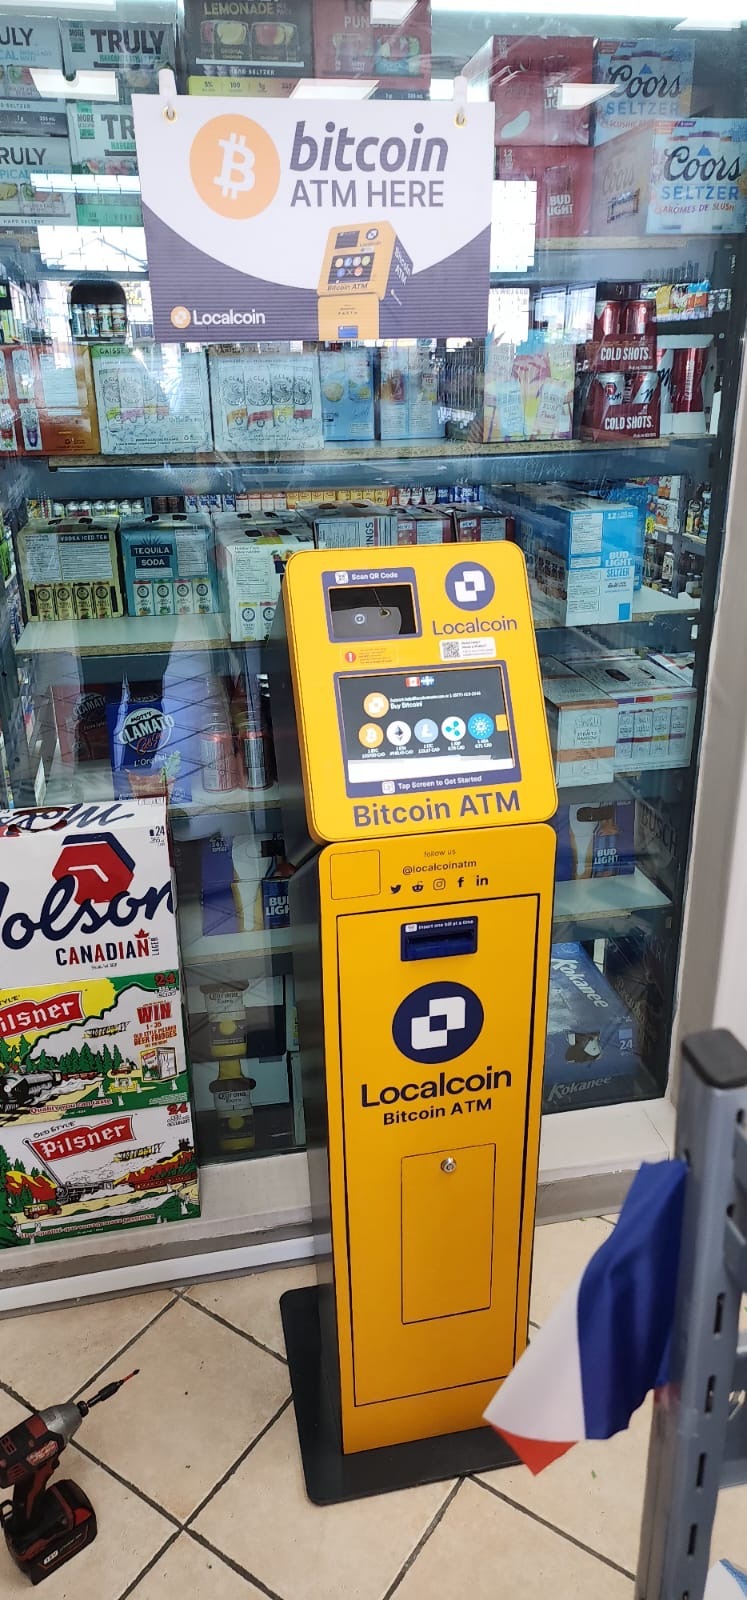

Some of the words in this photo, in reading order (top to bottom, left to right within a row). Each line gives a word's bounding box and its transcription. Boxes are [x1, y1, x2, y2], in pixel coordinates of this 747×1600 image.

[203, 2, 274, 15] LEMONADE
[90, 28, 165, 55] TRULY
[608, 64, 681, 98] Coors
[606, 101, 679, 116] SELTZER
[77, 113, 94, 123] MORE
[289, 120, 449, 173] bitcoin
[663, 145, 741, 182] Coors
[289, 179, 357, 208] ATM
[367, 179, 445, 207] HERE
[550, 194, 571, 205] BUD
[661, 185, 739, 201] SELTZER
[547, 204, 574, 216] LIGHT
[192, 308, 266, 326] Localcoin
[600, 346, 622, 361] COLD
[604, 417, 626, 431] COLD
[134, 547, 170, 555] TEQUILA
[608, 551, 630, 560] BUD
[141, 558, 165, 567] SODA
[605, 559, 633, 567] LIGHT
[380, 572, 398, 580] Code
[606, 568, 630, 578] SELTZER
[432, 615, 518, 636] Localcoin
[120, 714, 175, 745] CLAMATO
[398, 782, 411, 790] Tap
[412, 780, 435, 788] Screen
[457, 775, 482, 783] Started
[352, 797, 451, 827] Bitcoin
[460, 790, 521, 817] ATM
[155, 825, 165, 836] 24
[594, 854, 620, 865] LIGHT
[597, 847, 617, 857] BUD
[402, 860, 477, 875] @localcoinatm
[0, 874, 174, 950] olson
[55, 937, 150, 967] CANADIAN
[154, 971, 176, 987] 24
[551, 958, 609, 1008] Kokanee
[0, 999, 74, 1034] ilsner
[137, 1002, 172, 1024] WIN
[134, 1037, 150, 1046] BEER
[151, 1031, 177, 1042] FRIDGES
[620, 1039, 633, 1050] 24
[361, 1065, 513, 1108] Localcoin
[548, 1077, 612, 1101] Kokanee
[30, 1105, 59, 1115] Quality
[61, 1102, 75, 1111] you
[167, 1102, 188, 1115] 24
[383, 1105, 446, 1126] Bitcoin
[450, 1097, 492, 1116] ATM
[33, 1129, 49, 1138] OLD
[51, 1121, 74, 1132] STYLE
[40, 1125, 125, 1159] Pilsner
